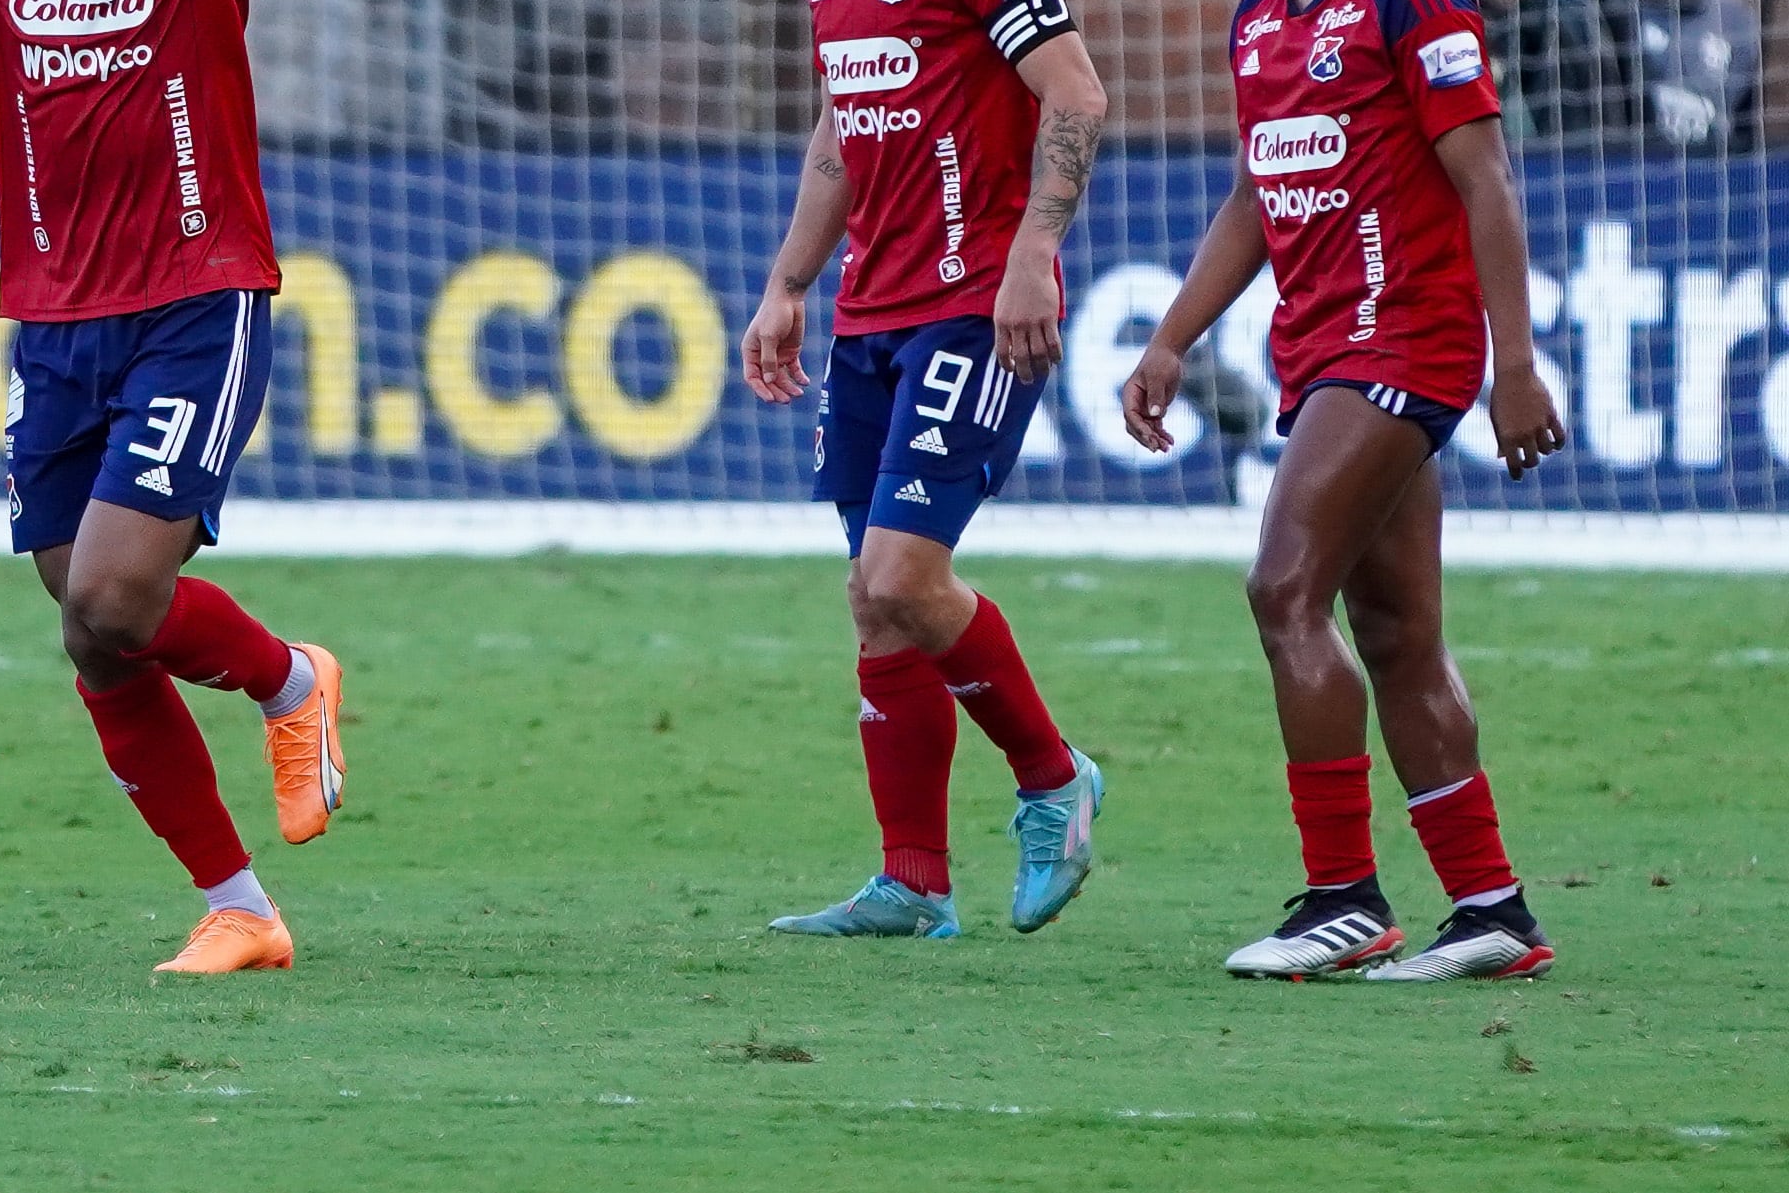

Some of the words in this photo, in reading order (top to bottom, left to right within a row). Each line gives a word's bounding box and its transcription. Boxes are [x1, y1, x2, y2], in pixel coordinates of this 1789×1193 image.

[20, 43, 153, 87] Wplay.co
[833, 102, 921, 146] play.co
[1253, 130, 1341, 162] Colanta
[28, 187, 42, 222] RON
[178, 170, 201, 208] RON
[1258, 183, 1350, 226] play.co
[915, 349, 974, 423] 9
[127, 396, 198, 465] 3
[909, 440, 949, 456] adidas
[134, 475, 174, 497] adidas
[894, 490, 932, 506] adidas
